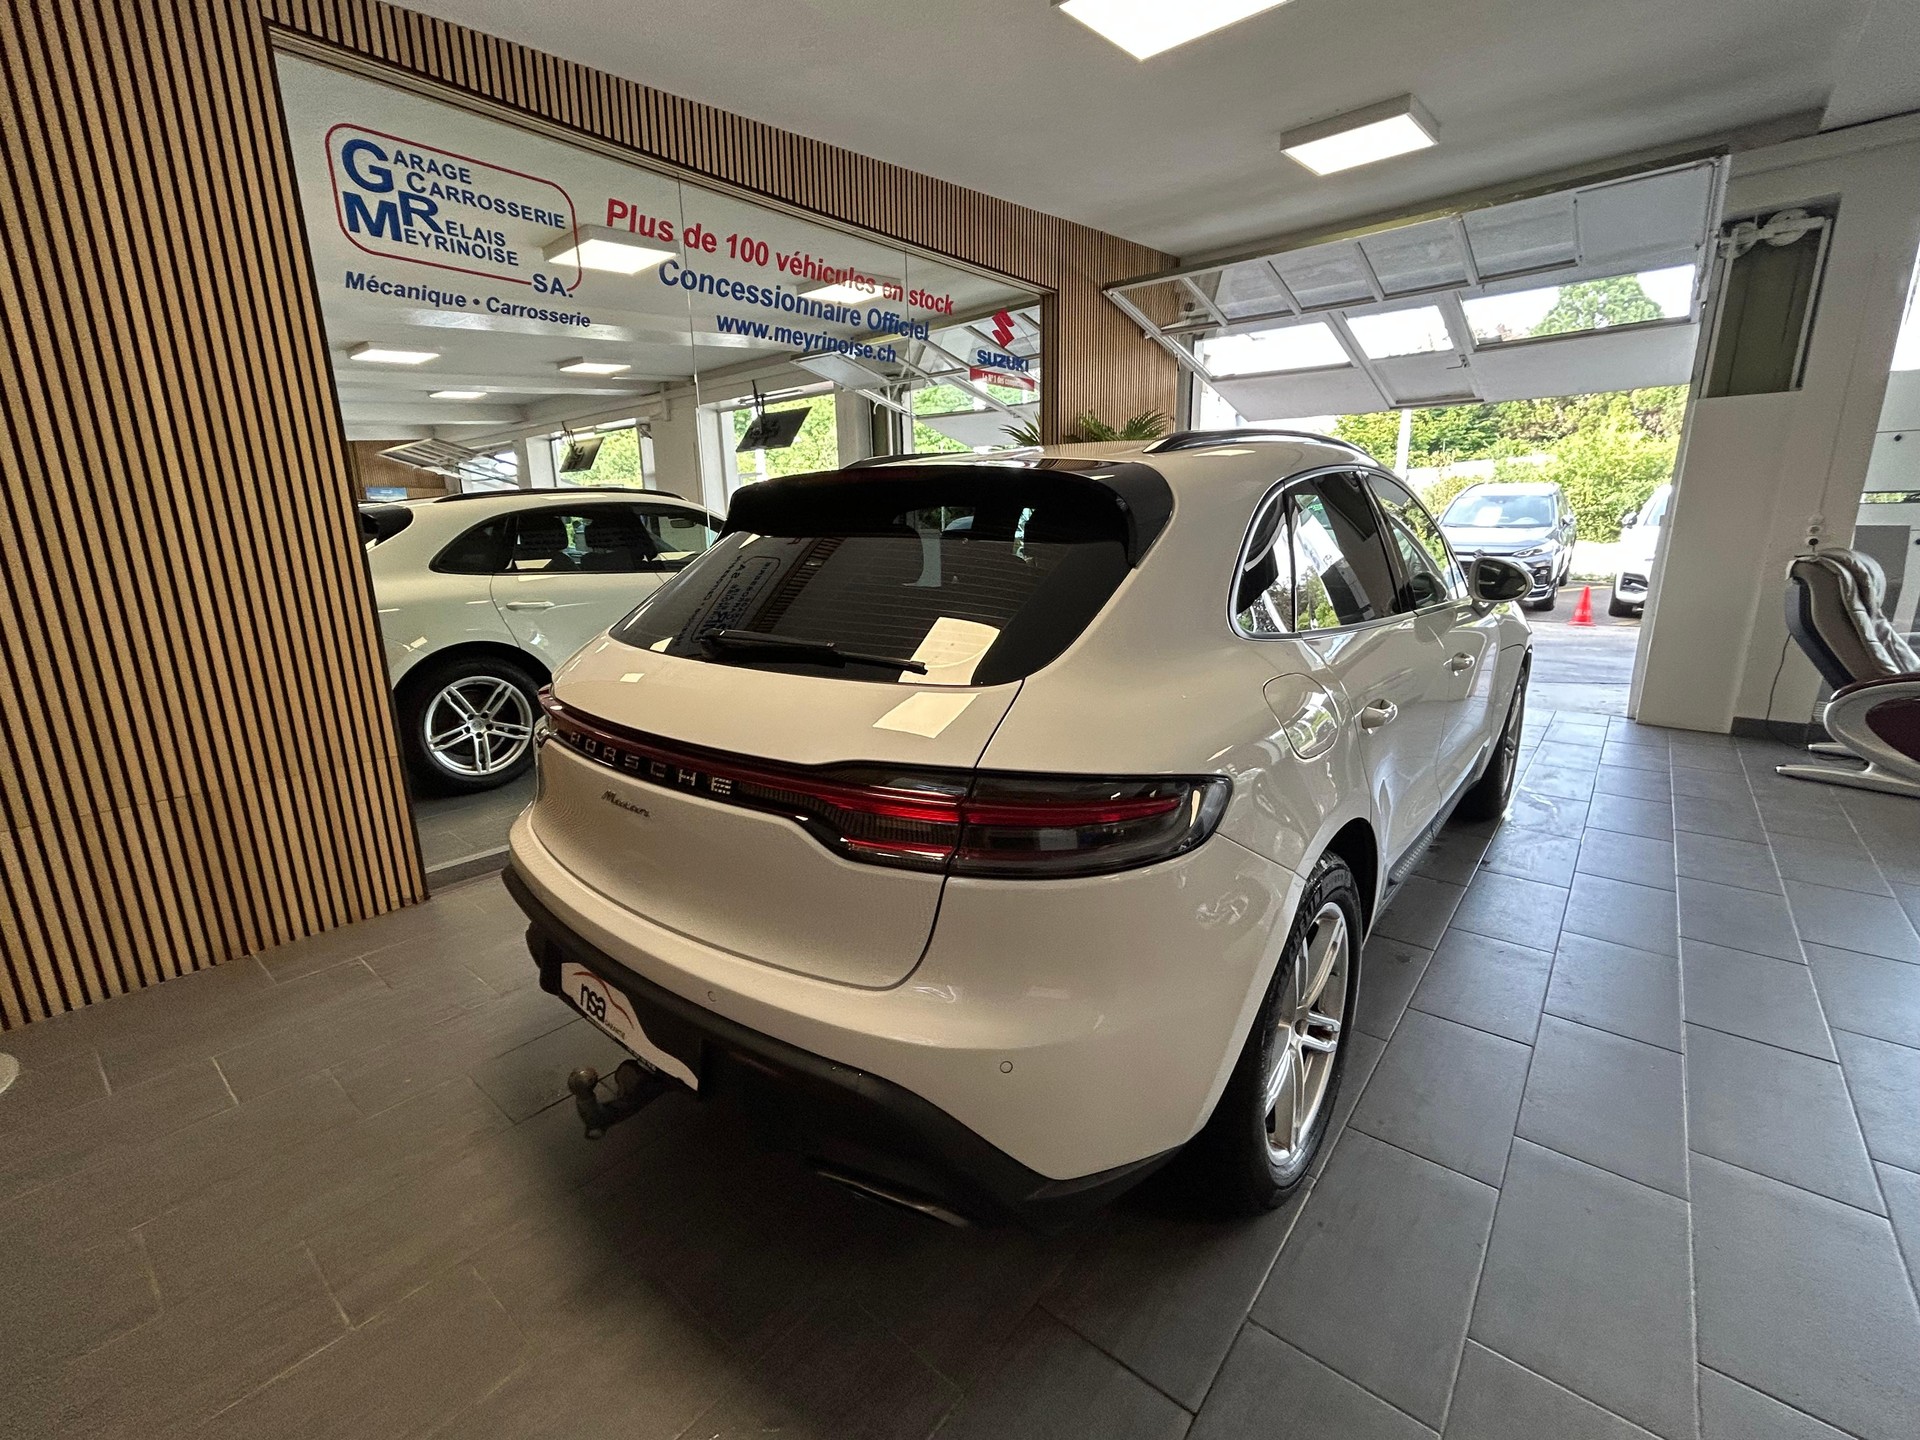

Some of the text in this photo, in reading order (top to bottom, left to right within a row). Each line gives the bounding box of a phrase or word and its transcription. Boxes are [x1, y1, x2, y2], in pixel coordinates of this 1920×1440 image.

[341, 138, 472, 194] GARAGE
[342, 191, 519, 266] MEYRINOISE
[397, 190, 506, 247] RELAIS
[406, 172, 566, 229] CARROSSERIE
[532, 273, 573, 297] SA.
[606, 197, 955, 316] Plus de 100 véhicules en stock
[345, 271, 591, 327] Mécanique Carrosserie
[658, 259, 930, 341] Concessionnaire Officiel
[716, 314, 897, 363] www.meyrinoise.ch
[976, 349, 1030, 372] SUZUKI
[569, 731, 733, 795] PORSCHE
